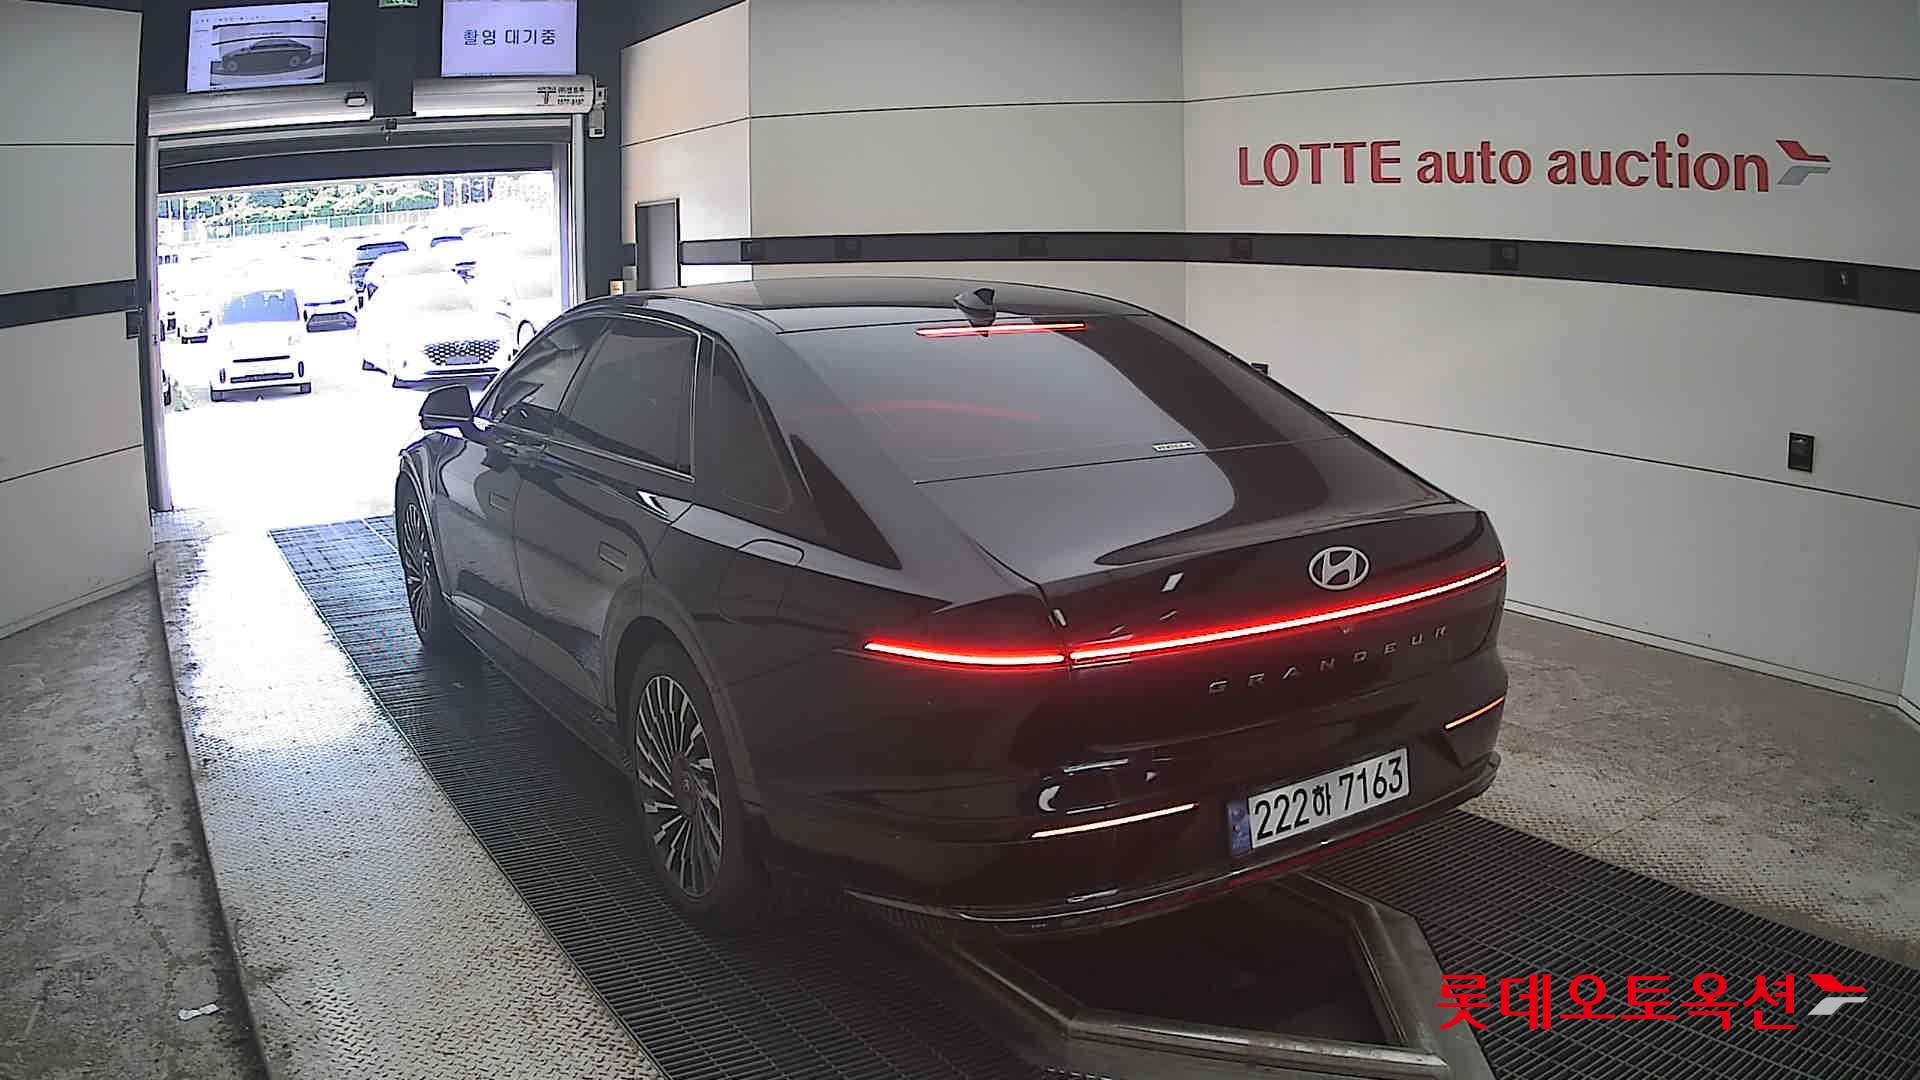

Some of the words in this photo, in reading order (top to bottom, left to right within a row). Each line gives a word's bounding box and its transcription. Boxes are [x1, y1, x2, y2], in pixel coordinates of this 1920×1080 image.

[504, 29, 557, 46] 대기중
[1238, 139, 1401, 186] LOTTE
[1416, 141, 1532, 184] auto
[1547, 133, 1770, 192] auction
[1208, 626, 1447, 694] GRANDEUR
[1254, 782, 1332, 841] 222하
[1338, 755, 1404, 811] 7163
